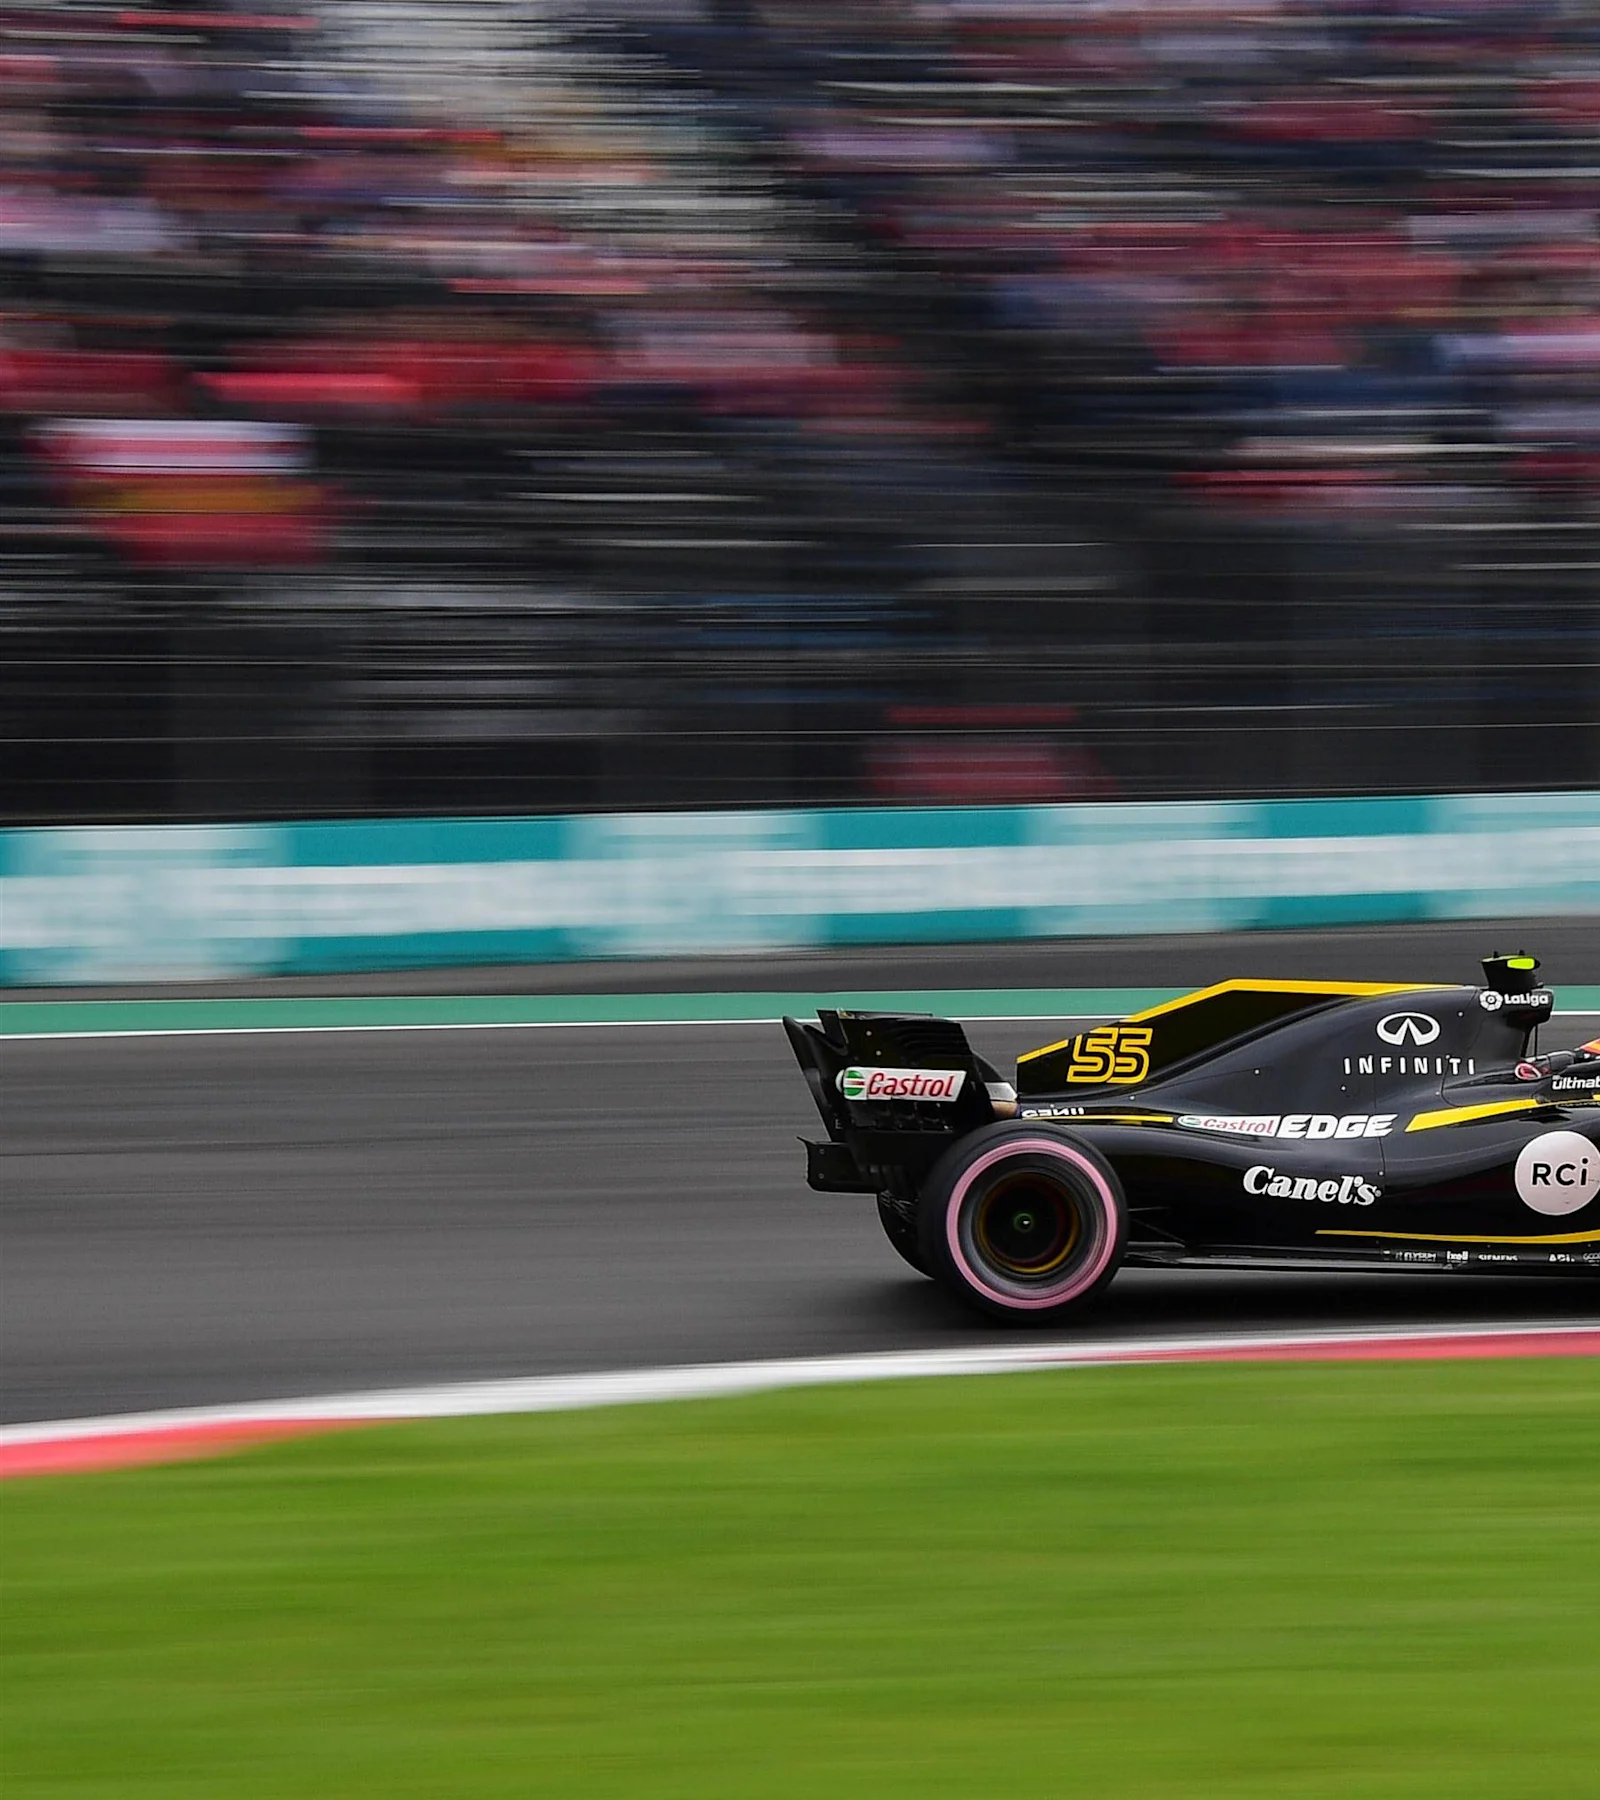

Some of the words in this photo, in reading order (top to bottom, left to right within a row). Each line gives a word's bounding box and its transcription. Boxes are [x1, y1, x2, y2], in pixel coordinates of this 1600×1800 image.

[1504, 993, 1549, 1007] LaLiga
[1066, 1026, 1154, 1083] 55
[1344, 1055, 1475, 1075] INFINITI
[867, 1072, 955, 1097] Castrol
[1202, 1118, 1275, 1135] Castrol
[1276, 1114, 1398, 1139] EDGE
[1243, 1165, 1378, 1206] Canel's
